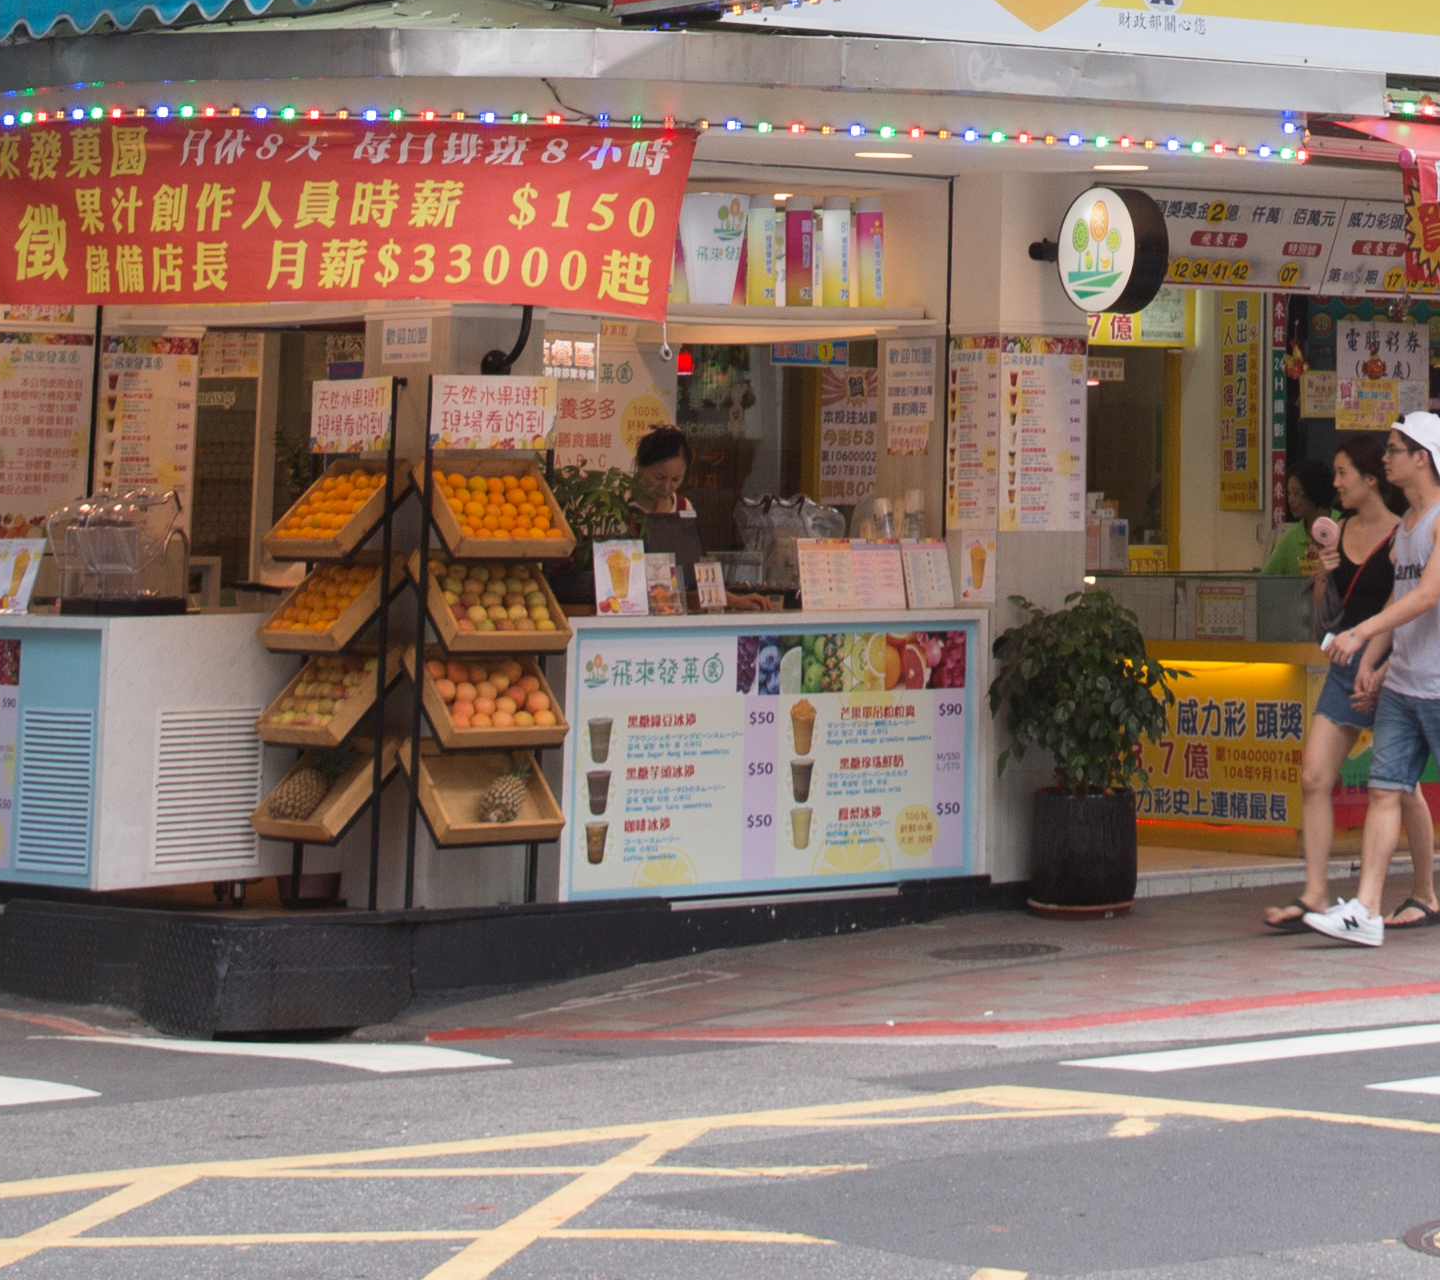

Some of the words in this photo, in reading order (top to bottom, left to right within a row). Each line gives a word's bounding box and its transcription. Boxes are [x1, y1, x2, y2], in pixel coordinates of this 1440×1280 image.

[1118, 11, 1208, 36] 財政部關心您
[76, 180, 461, 236] 果汁創作人員時薪
[508, 189, 656, 238] $150
[85, 241, 229, 296] 儲備店長
[1173, 260, 1190, 278] 12
[1191, 261, 1210, 279] 34
[1211, 262, 1230, 280] 41
[1231, 263, 1249, 281] 42
[1280, 265, 1298, 283] 07
[1346, 328, 1422, 354] 電腦彩券
[319, 386, 388, 411] 天然水果現打
[443, 384, 550, 407] 天然水果現打
[317, 410, 383, 437] 現場看的到
[442, 409, 545, 434] 現場看的到
[612, 651, 725, 686] 飛來發菓園
[938, 702, 963, 718] $90
[1177, 698, 1247, 738] 威力彩
[1255, 701, 1304, 741] 頭獎
[936, 800, 961, 816] $50
[746, 813, 773, 829] $50
